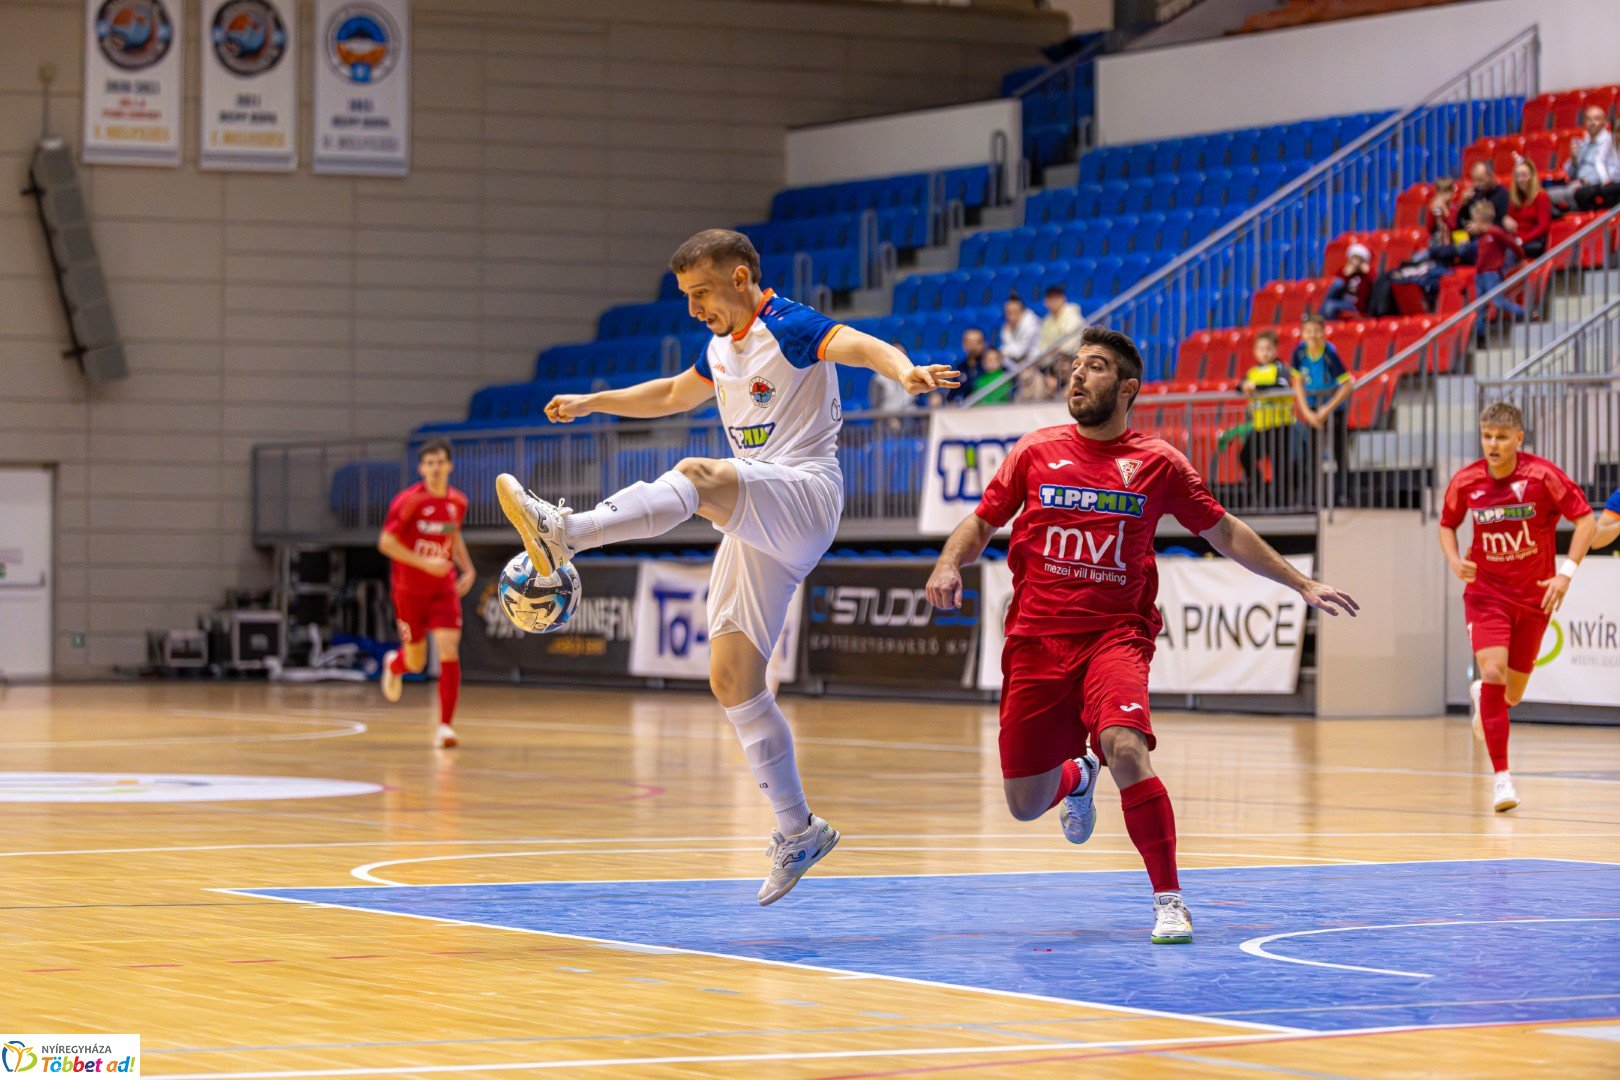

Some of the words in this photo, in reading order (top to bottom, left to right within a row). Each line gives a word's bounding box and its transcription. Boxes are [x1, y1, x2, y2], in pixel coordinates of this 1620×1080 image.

[1043, 520, 1127, 569] mvl
[1482, 519, 1536, 553] mvl
[1044, 562, 1071, 576] mezei
[1074, 567, 1087, 579] vill
[1090, 570, 1127, 586] lighting
[1184, 603, 1297, 649] PINCE
[1569, 613, 1620, 649] NYÍR
